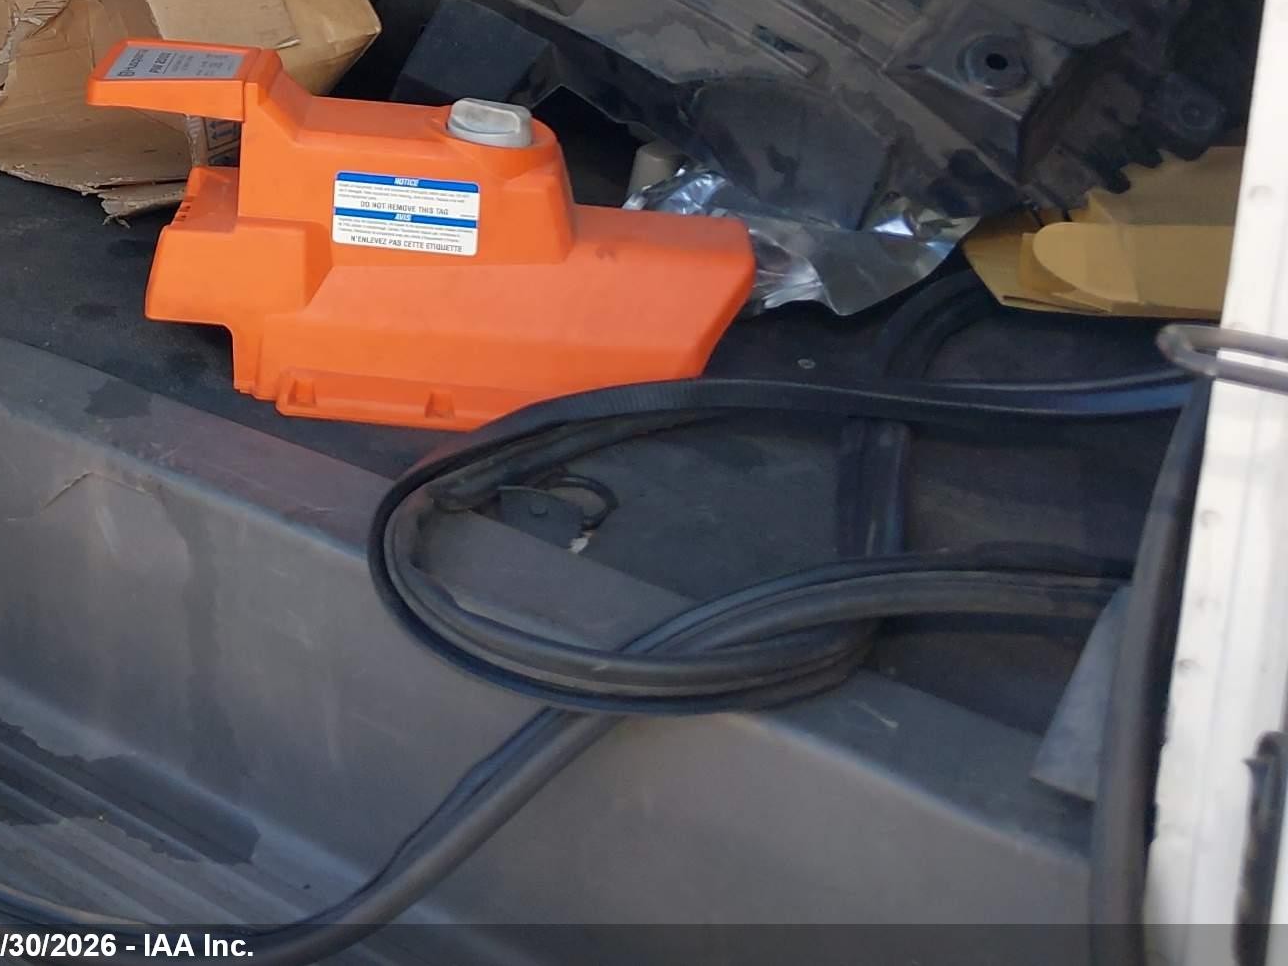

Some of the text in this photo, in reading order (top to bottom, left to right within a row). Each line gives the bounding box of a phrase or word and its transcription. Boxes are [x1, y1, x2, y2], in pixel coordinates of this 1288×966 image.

[394, 177, 419, 187] NOTICE
[360, 201, 371, 209] DO
[371, 202, 385, 210] NOT
[387, 203, 417, 213] REMOVE
[418, 207, 434, 215] THIS
[350, 235, 387, 245] N'ENLEVEZ
[388, 237, 402, 246] PAS
[403, 239, 424, 249] CETTE
